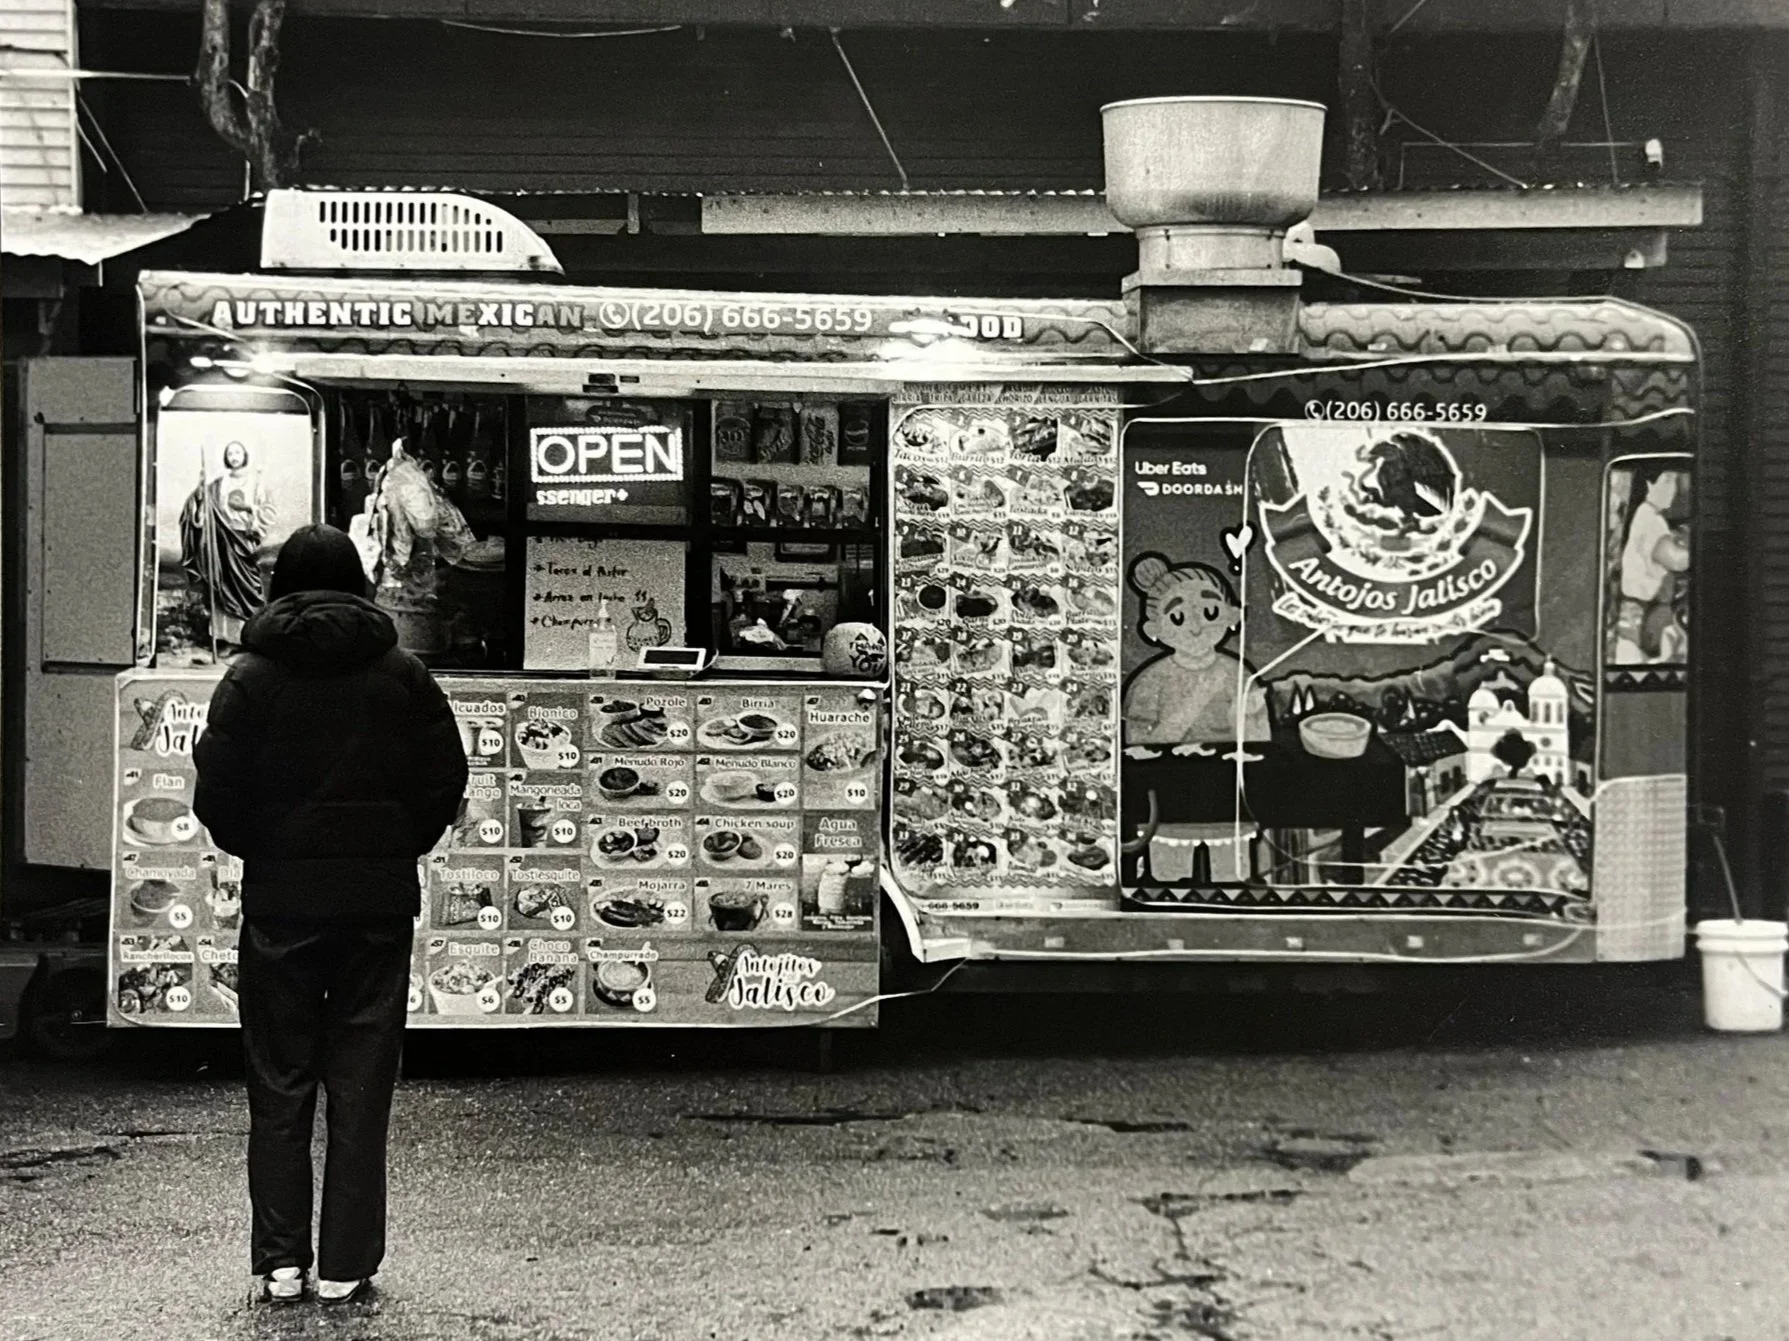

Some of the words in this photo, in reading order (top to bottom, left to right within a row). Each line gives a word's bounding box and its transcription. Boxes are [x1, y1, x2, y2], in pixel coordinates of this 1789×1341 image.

[212, 301, 413, 327] AUTHENTIC
[424, 301, 586, 329] MEXICAN
[631, 302, 713, 331] (206)
[722, 304, 873, 332] 666-5659
[960, 314, 1023, 338] OOD
[1326, 402, 1381, 421] (206)
[1387, 403, 1487, 421] 666-5659
[537, 434, 677, 474] OPEN
[1135, 461, 1170, 475] Uber
[1172, 461, 1207, 475] Eats
[1162, 483, 1243, 495] DOORDASH
[1288, 557, 1398, 610] Antojos
[1402, 559, 1497, 614] Jalisco
[453, 700, 506, 715] icuados
[645, 696, 687, 707] Pozole
[741, 698, 776, 709] Birria
[528, 706, 578, 719] Bionico
[809, 711, 871, 724] Huarache
[669, 729, 688, 738] $20
[777, 730, 796, 739] $20
[481, 738, 500, 747] $10
[558, 751, 577, 760] $10
[660, 757, 685, 769] Rojo
[715, 757, 758, 768] Menudo
[760, 758, 796, 768] Blanco
[153, 773, 185, 789] Flan
[469, 773, 496, 786] ruit
[465, 786, 502, 800] ango
[510, 783, 582, 799] Mangoneada
[668, 788, 687, 797] $20
[776, 789, 795, 798] $20
[847, 788, 865, 797] $10
[648, 818, 682, 828] broth
[715, 818, 762, 829] Chicken
[765, 819, 795, 830] soup
[819, 817, 857, 833] Agua
[481, 827, 500, 836] $10
[554, 827, 573, 836] $10
[814, 834, 862, 847] Fresca
[667, 850, 687, 859] $20
[775, 851, 794, 860] $20
[638, 880, 685, 891] Mojarra
[756, 881, 791, 891] Mares
[480, 914, 499, 923] $10
[553, 914, 572, 923] $10
[667, 909, 686, 918] $22
[775, 910, 793, 918] $28
[449, 942, 500, 958] Esquite
[529, 939, 571, 952] Choco
[200, 949, 239, 963] Chet
[529, 952, 579, 964] Banana
[590, 950, 659, 962] Champurrado
[738, 953, 822, 978] Antojitos
[169, 994, 188, 1004] $10
[729, 975, 836, 1011] Jalisco
[482, 996, 495, 1005] $6
